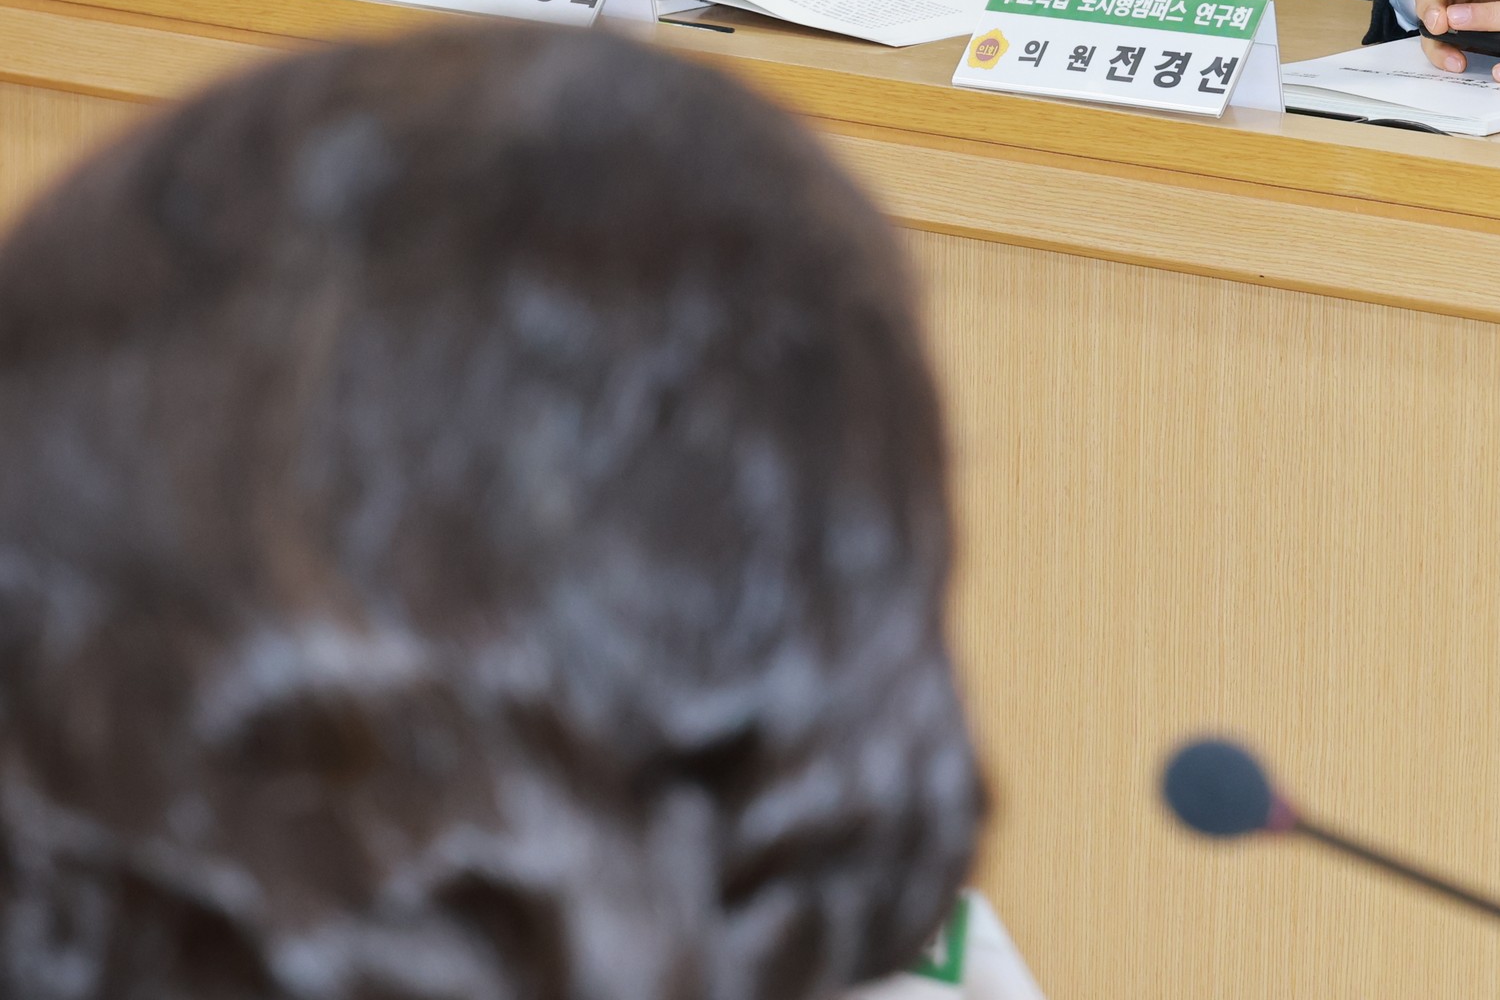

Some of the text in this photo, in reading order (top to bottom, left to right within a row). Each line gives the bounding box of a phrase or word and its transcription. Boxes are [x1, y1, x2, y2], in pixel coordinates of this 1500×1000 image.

[1193, 2, 1253, 30] 연구회
[976, 45, 998, 57] 의회
[1106, 45, 1240, 94] 전경선
